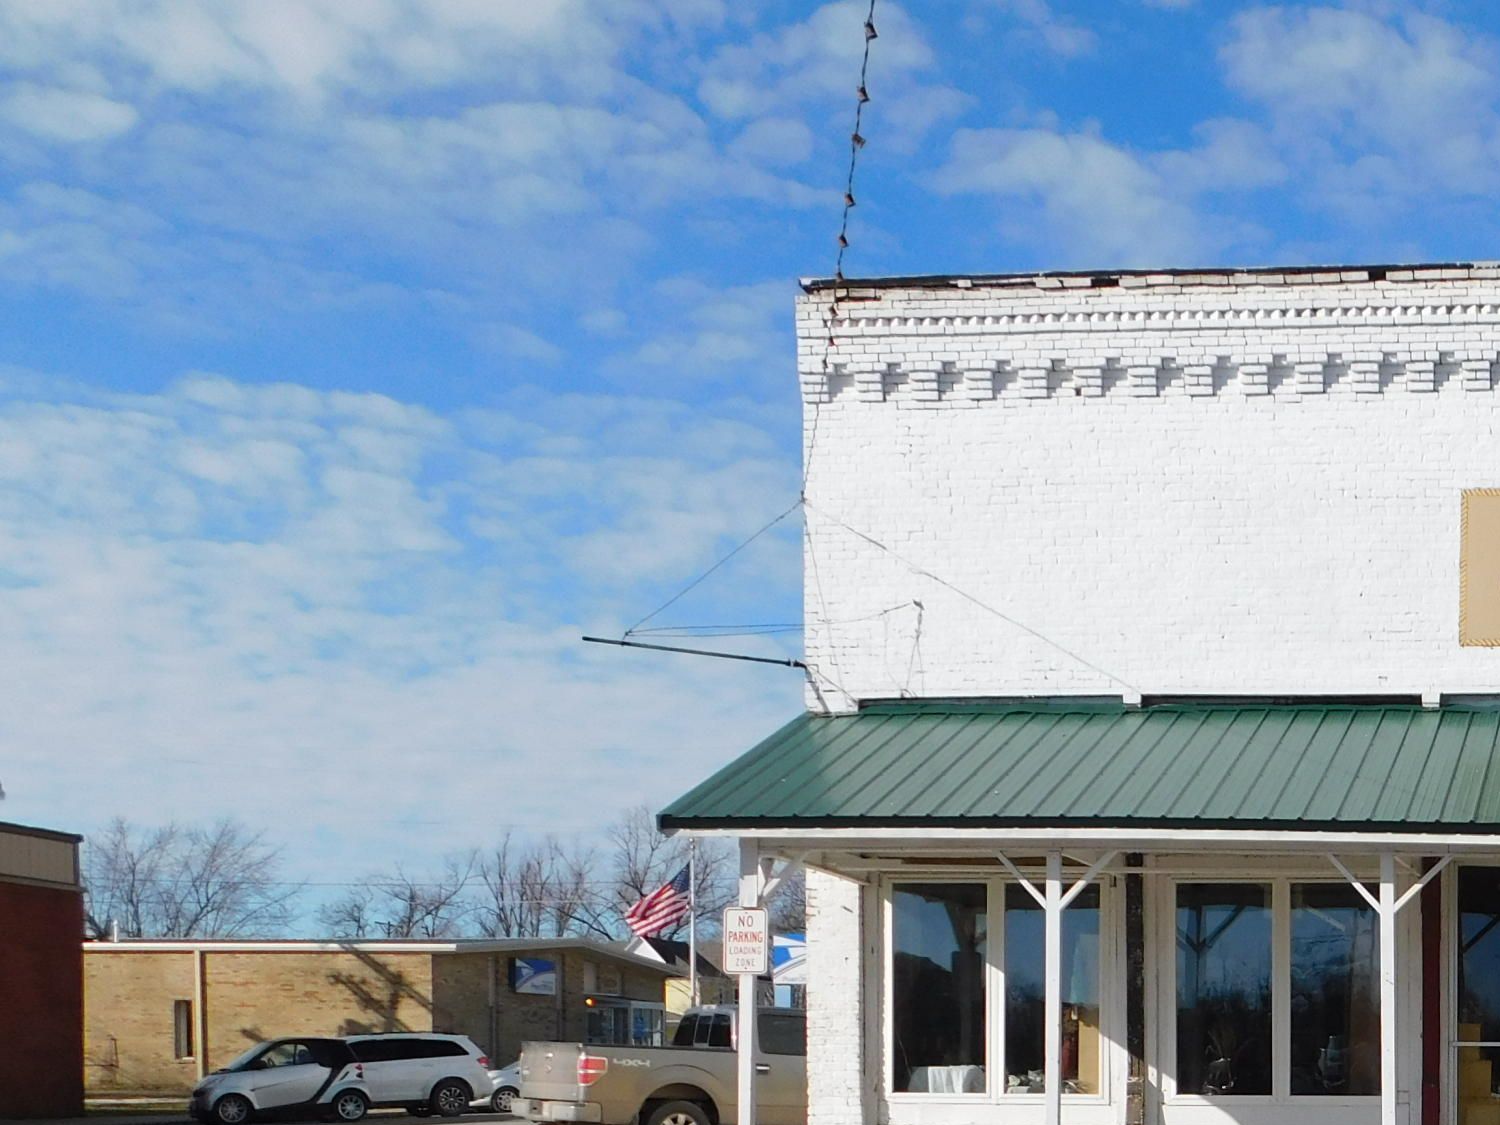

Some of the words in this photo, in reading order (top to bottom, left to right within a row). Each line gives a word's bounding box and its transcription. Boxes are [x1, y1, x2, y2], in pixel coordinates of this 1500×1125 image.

[738, 915, 754, 927] NO
[728, 931, 763, 943] PARKING
[729, 946, 762, 955] LOADING
[736, 958, 756, 967] ZONE
